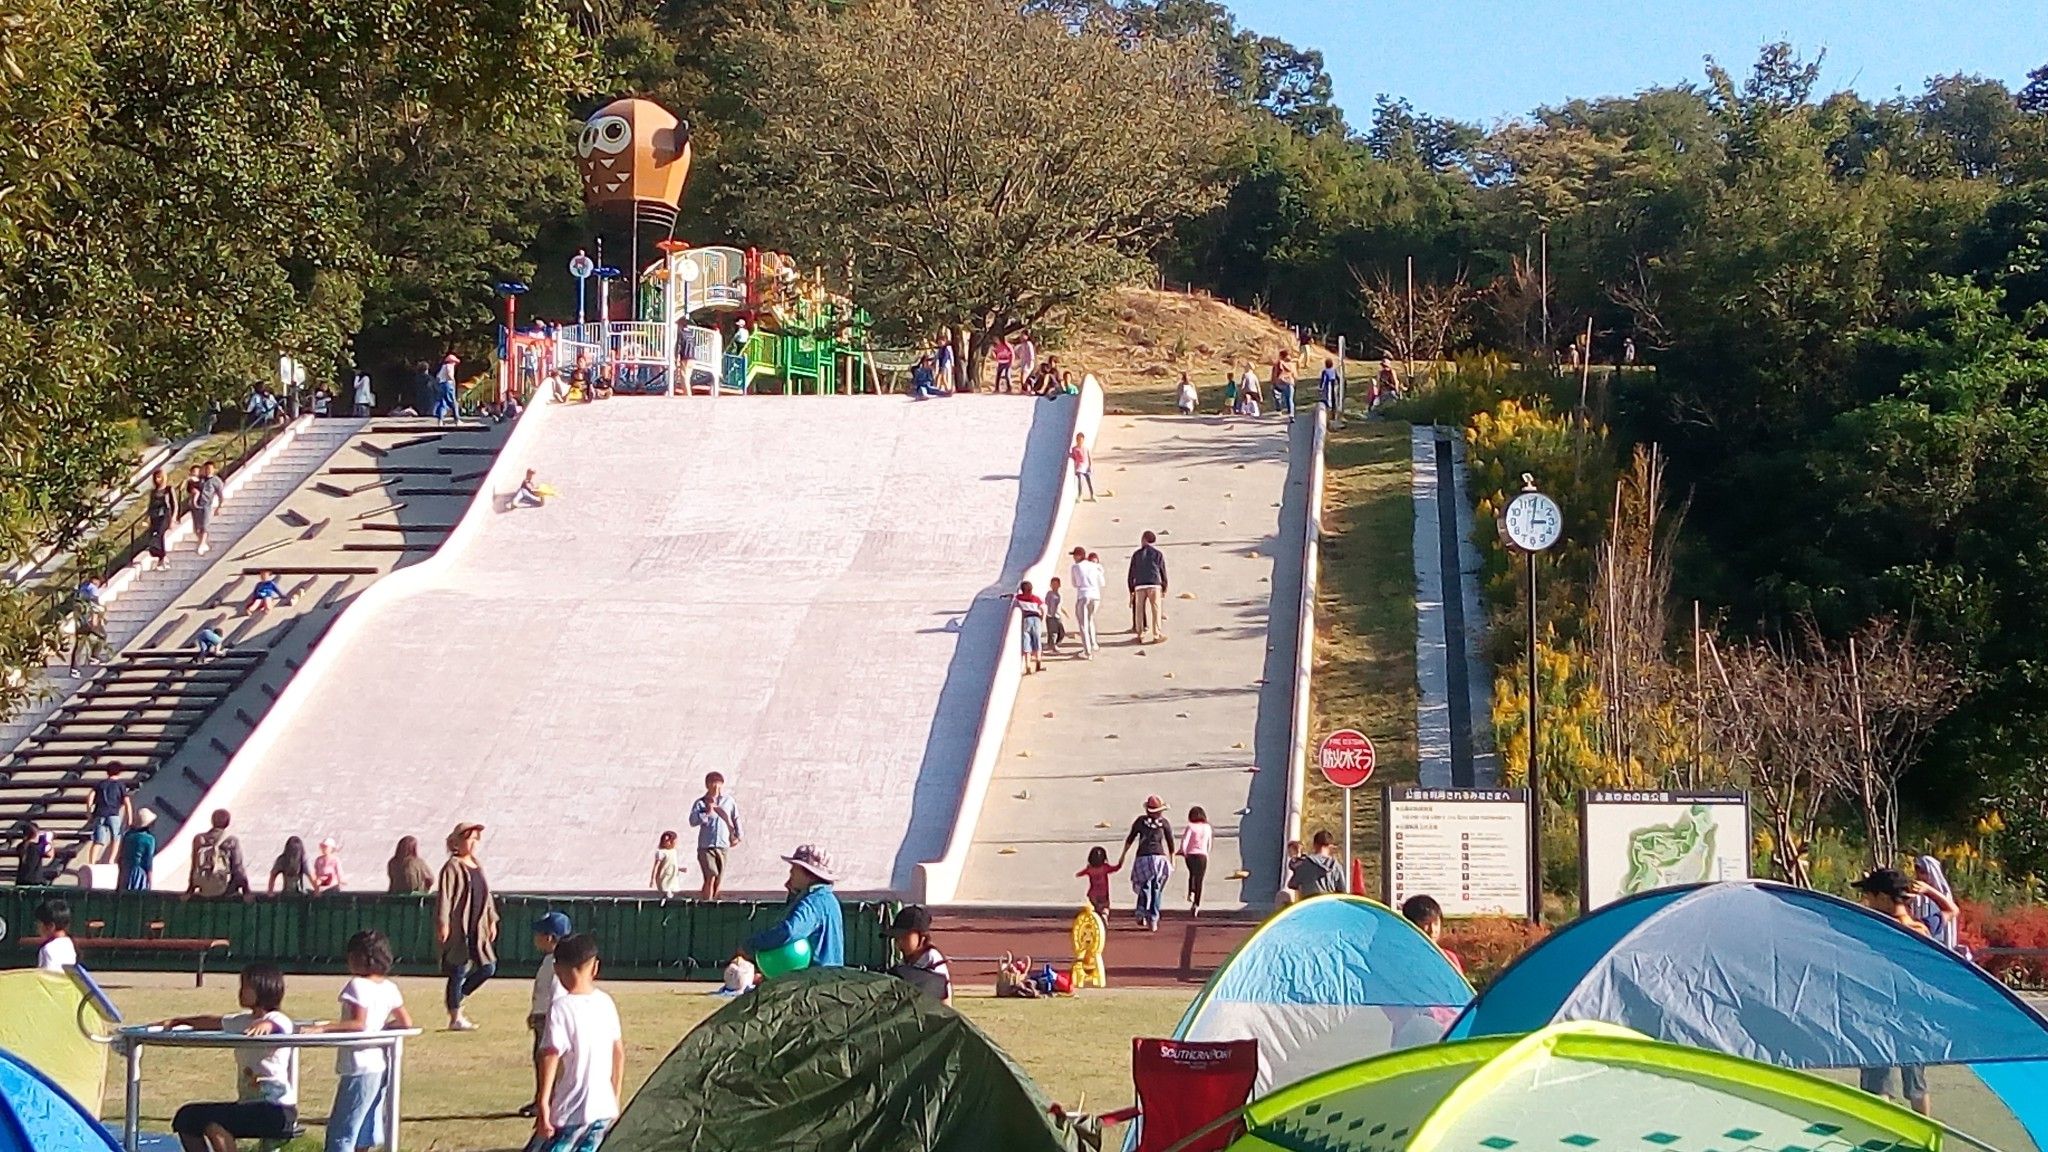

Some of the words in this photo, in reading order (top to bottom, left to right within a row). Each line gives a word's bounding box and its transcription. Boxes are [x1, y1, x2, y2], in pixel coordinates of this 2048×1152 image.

[1511, 508, 1521, 516] 10
[1322, 748, 1372, 769] 防火水そう
